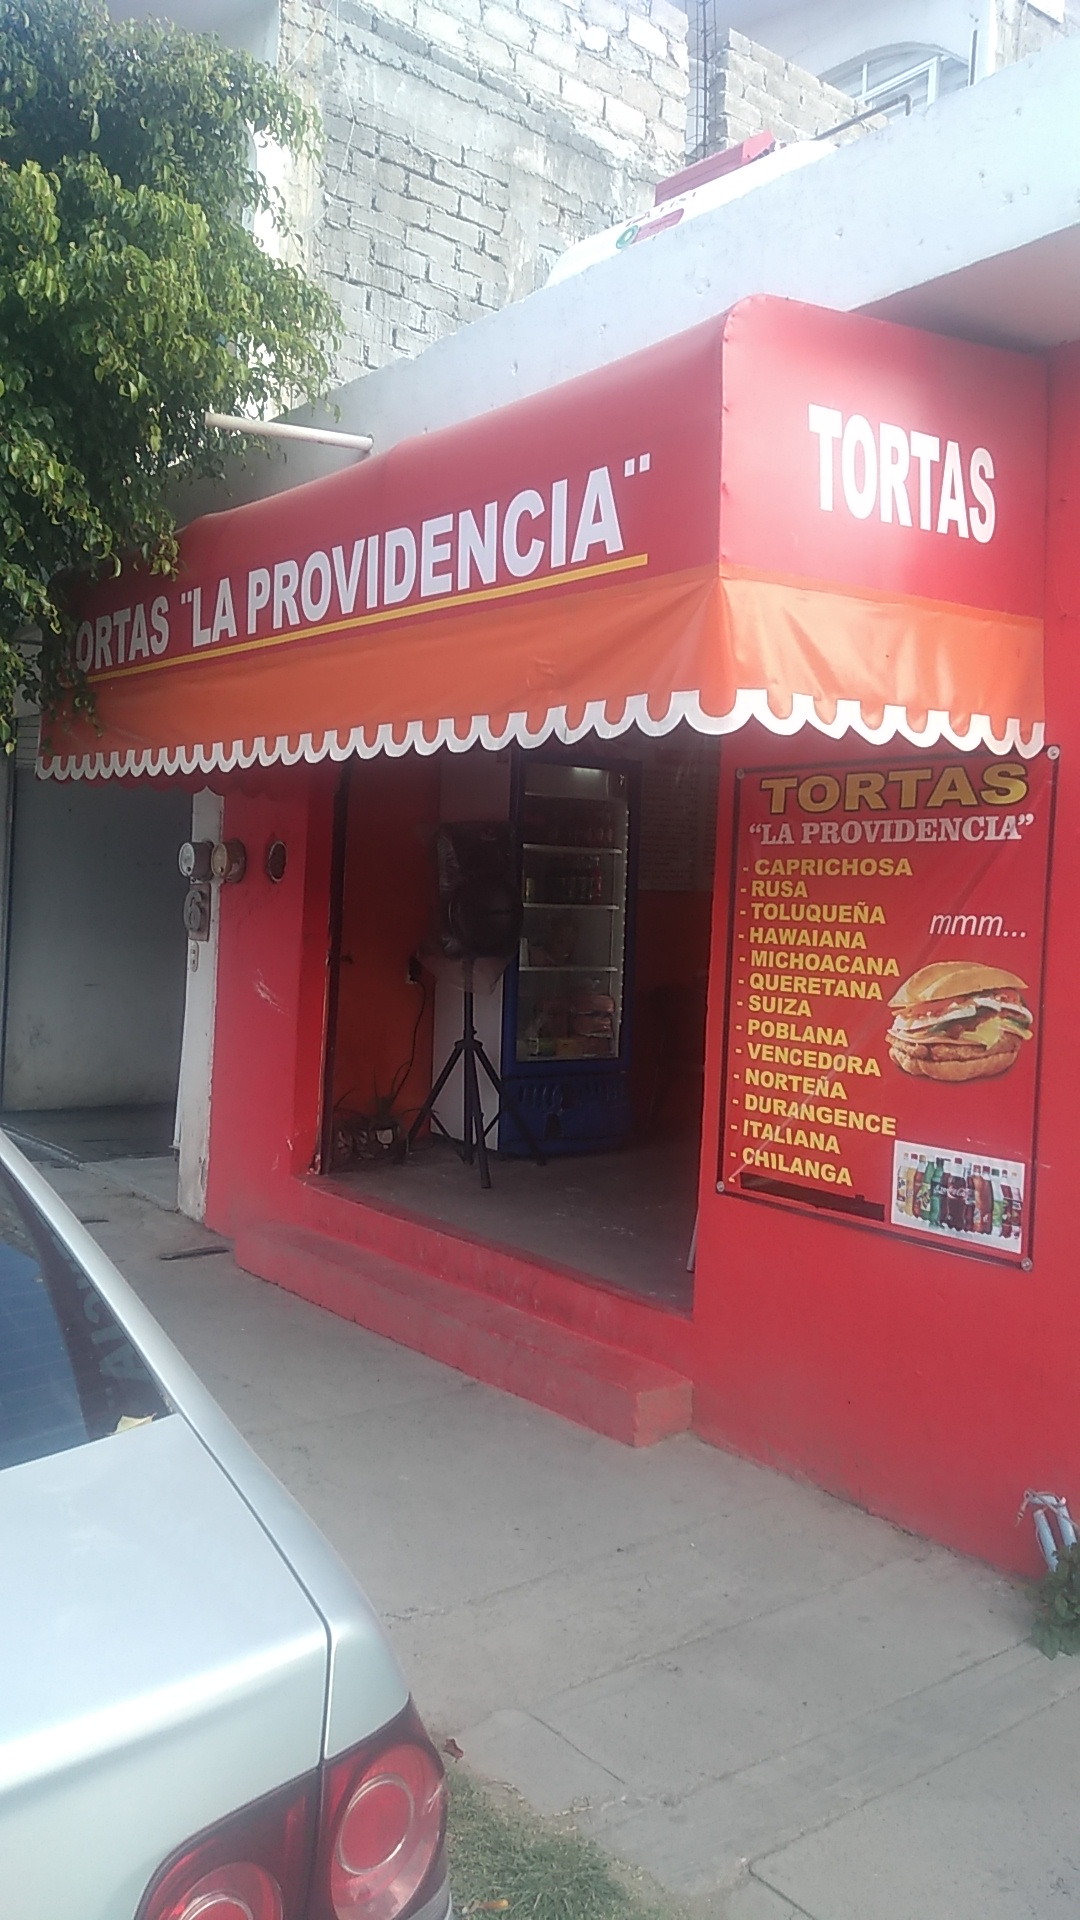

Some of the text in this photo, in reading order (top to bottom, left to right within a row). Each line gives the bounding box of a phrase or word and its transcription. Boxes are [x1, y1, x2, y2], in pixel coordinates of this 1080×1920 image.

[807, 403, 996, 544] TORTAS
[66, 595, 170, 673] ORTAS
[761, 763, 1029, 814] TORTAS
[754, 858, 913, 876] CAPRICHOSA
[751, 880, 808, 898] RUSA
[751, 901, 886, 924] TOLUQUEÑA
[749, 926, 867, 949] HAWAIANA
[750, 950, 900, 977] MICHOACANA
[749, 972, 883, 1000] QUERETANA
[748, 995, 812, 1017] SUIZA
[747, 1018, 848, 1047] POBLANA
[747, 1042, 882, 1077] VENCEDORA
[745, 1068, 848, 1100] NORTEÑA
[744, 1093, 897, 1136] DURANGENCE
[742, 1119, 841, 1154] ITALIANA
[742, 1147, 853, 1186] CHILANGA
